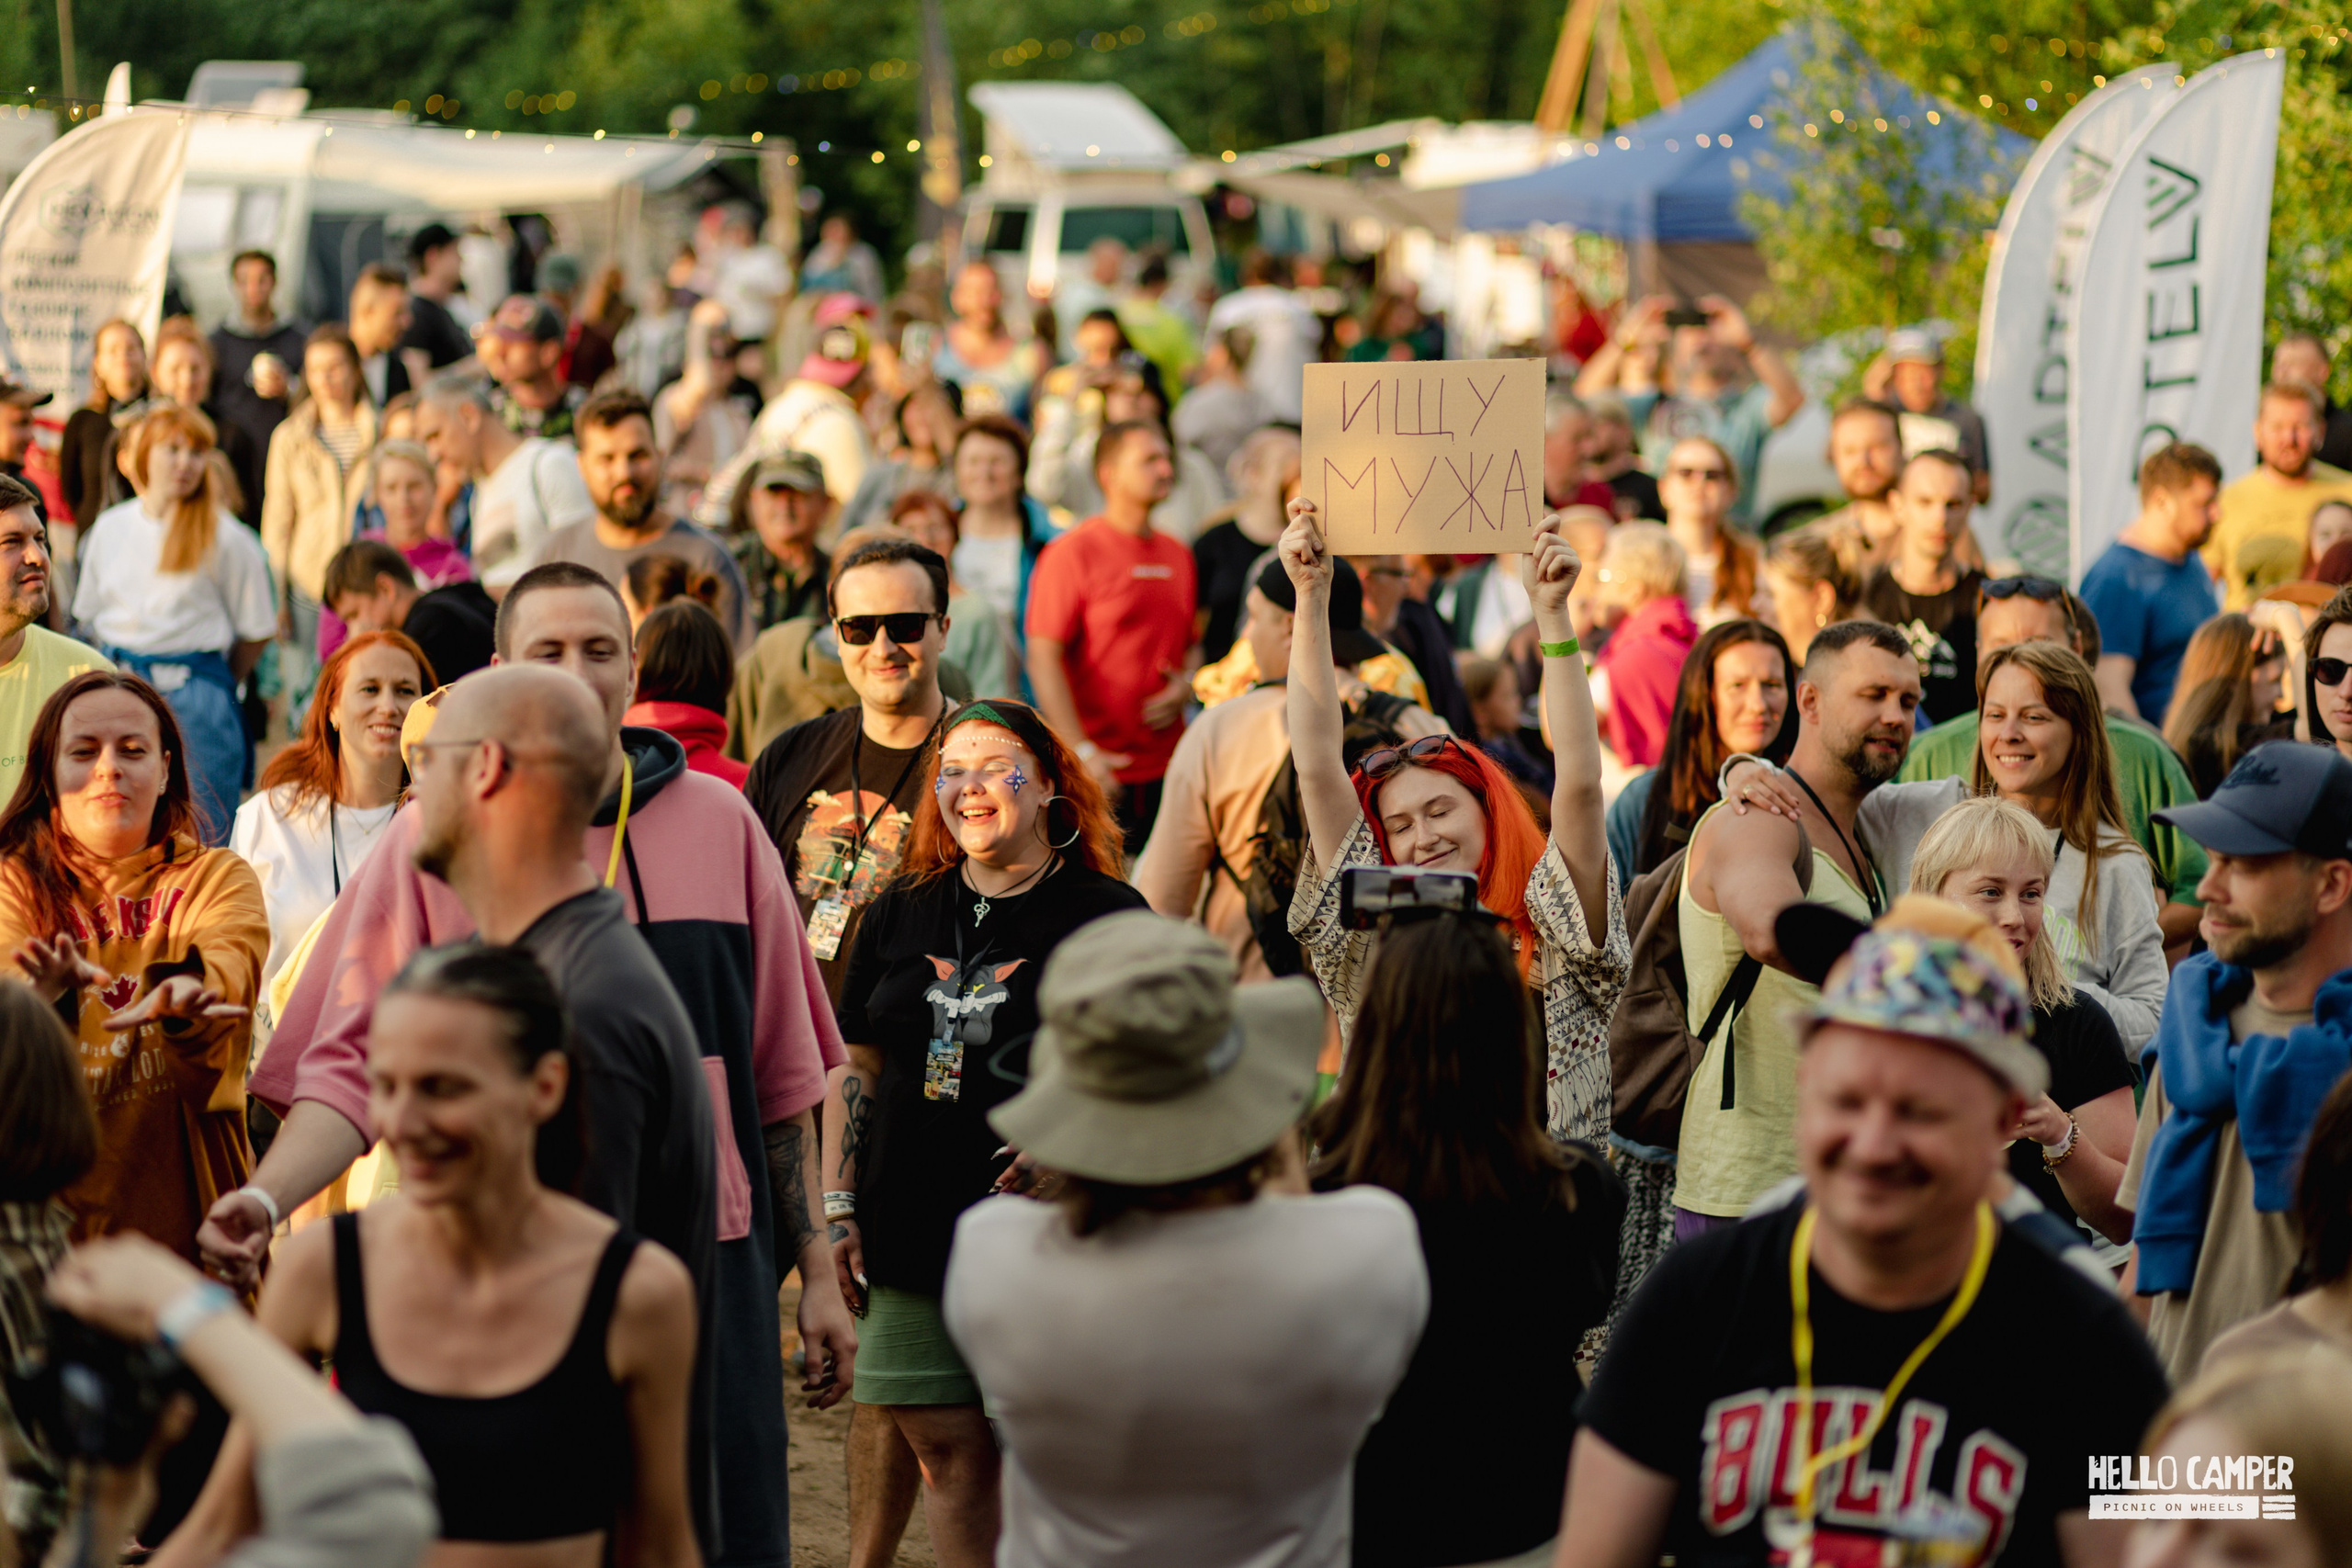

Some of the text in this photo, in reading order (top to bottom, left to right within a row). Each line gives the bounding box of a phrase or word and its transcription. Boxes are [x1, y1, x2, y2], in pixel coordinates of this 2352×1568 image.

[1342, 374, 1506, 445] ИЩУ
[1323, 448, 1532, 536] МУЖА
[1700, 1385, 2028, 1568] BULLS
